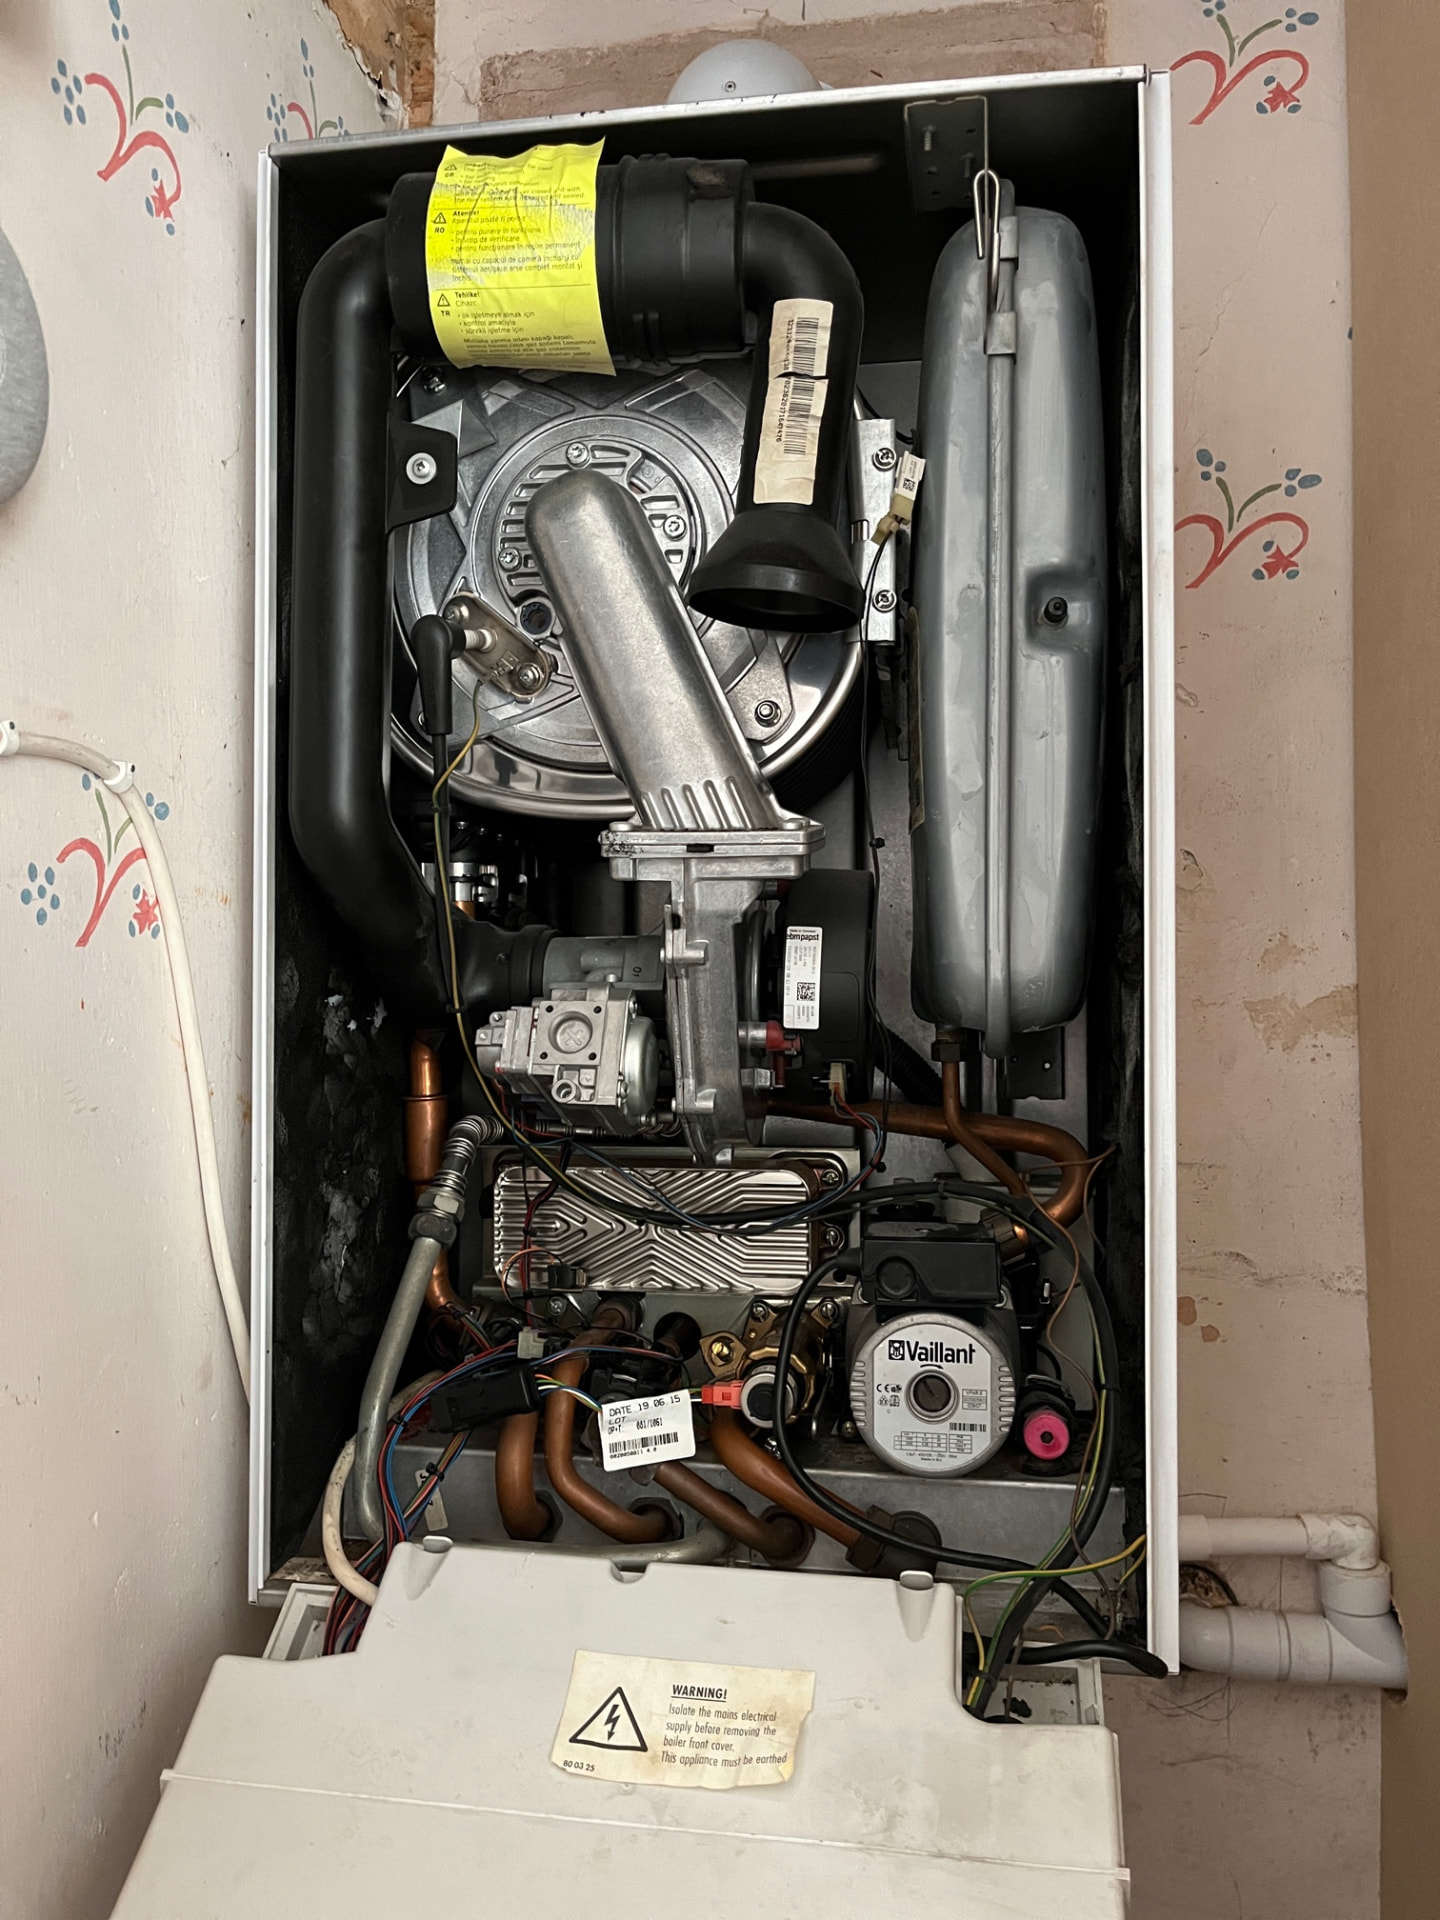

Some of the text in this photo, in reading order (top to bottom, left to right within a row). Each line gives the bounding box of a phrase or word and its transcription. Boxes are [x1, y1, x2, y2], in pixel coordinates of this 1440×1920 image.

[906, 1340, 976, 1364] Vaillant
[672, 1684, 728, 1699] WARNING!
[668, 1703, 777, 1722] Isolate the mains electrical
[665, 1720, 777, 1738] supply before removing the
[663, 1736, 735, 1752] boiler front cover.
[661, 1750, 787, 1768] This appliance must be earthed
